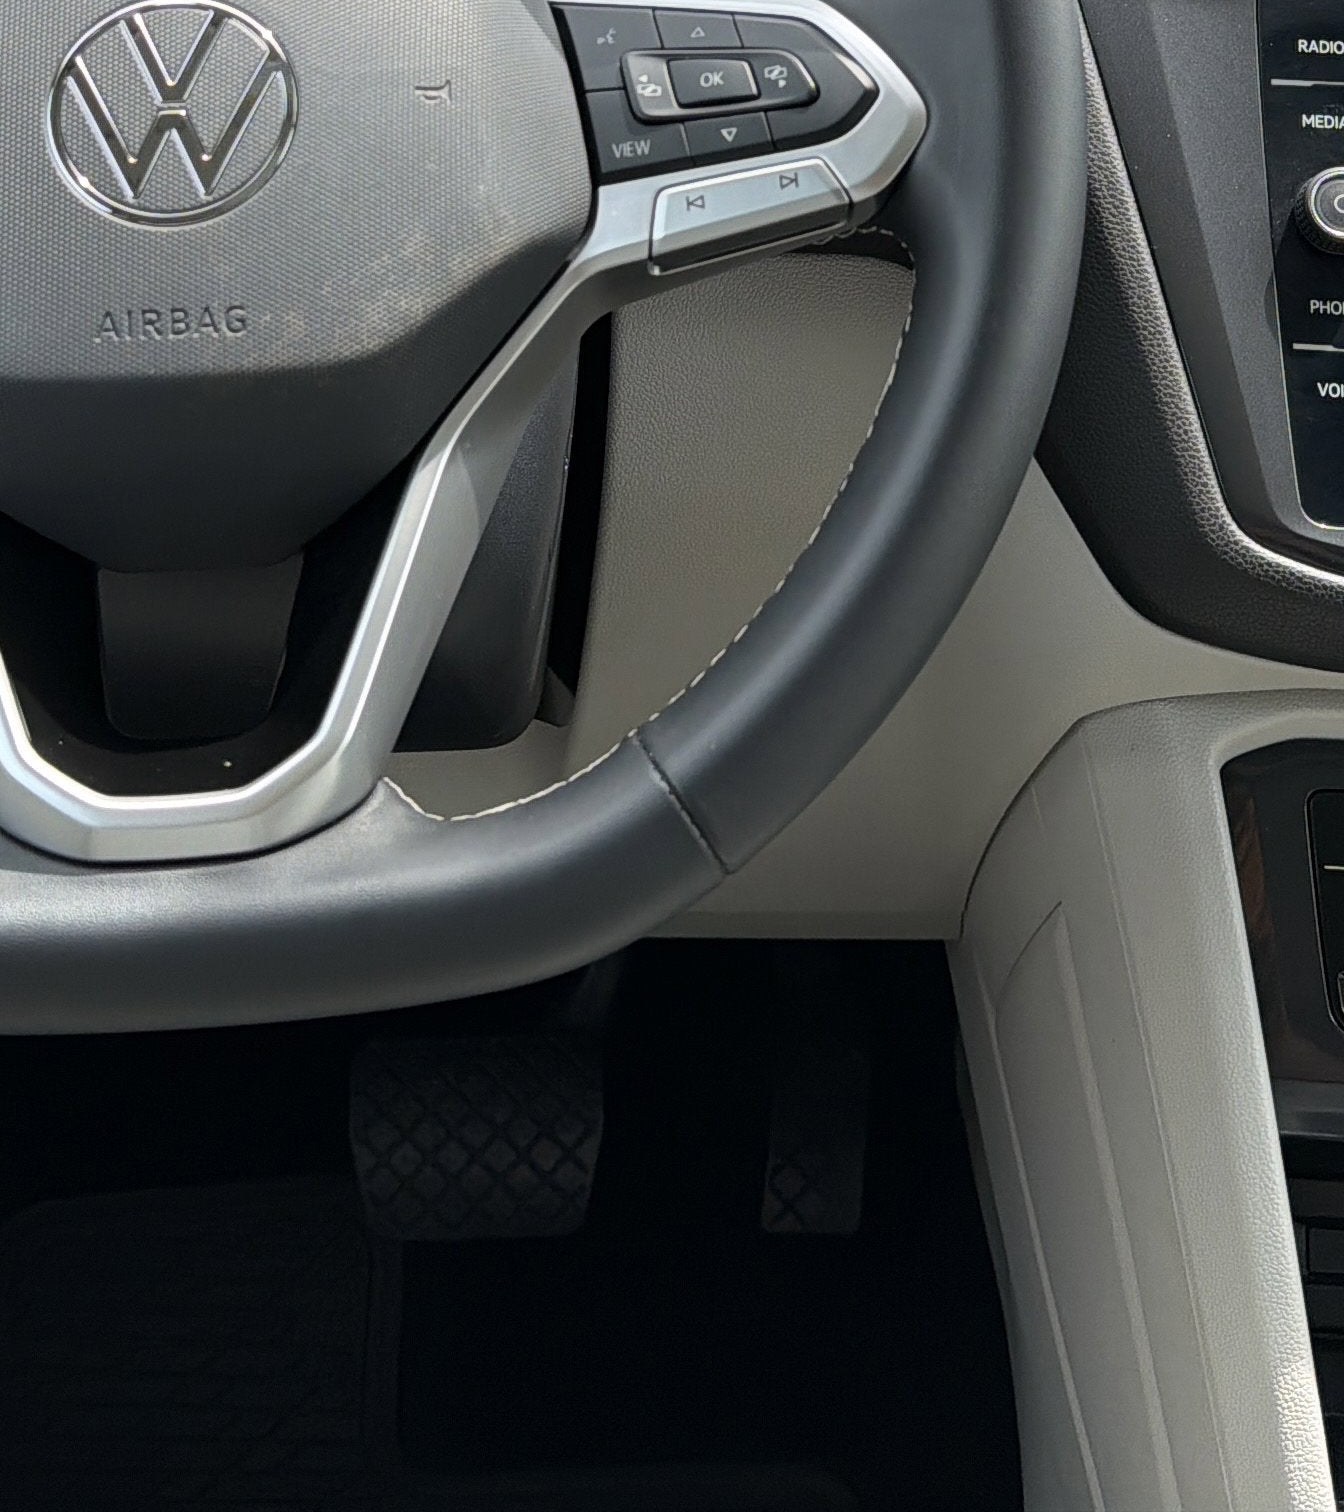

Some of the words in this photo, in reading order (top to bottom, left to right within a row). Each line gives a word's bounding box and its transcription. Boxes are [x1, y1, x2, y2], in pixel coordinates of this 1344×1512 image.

[699, 71, 724, 88] OK
[611, 139, 651, 159] VIEW
[94, 305, 250, 344] AIRBAG
